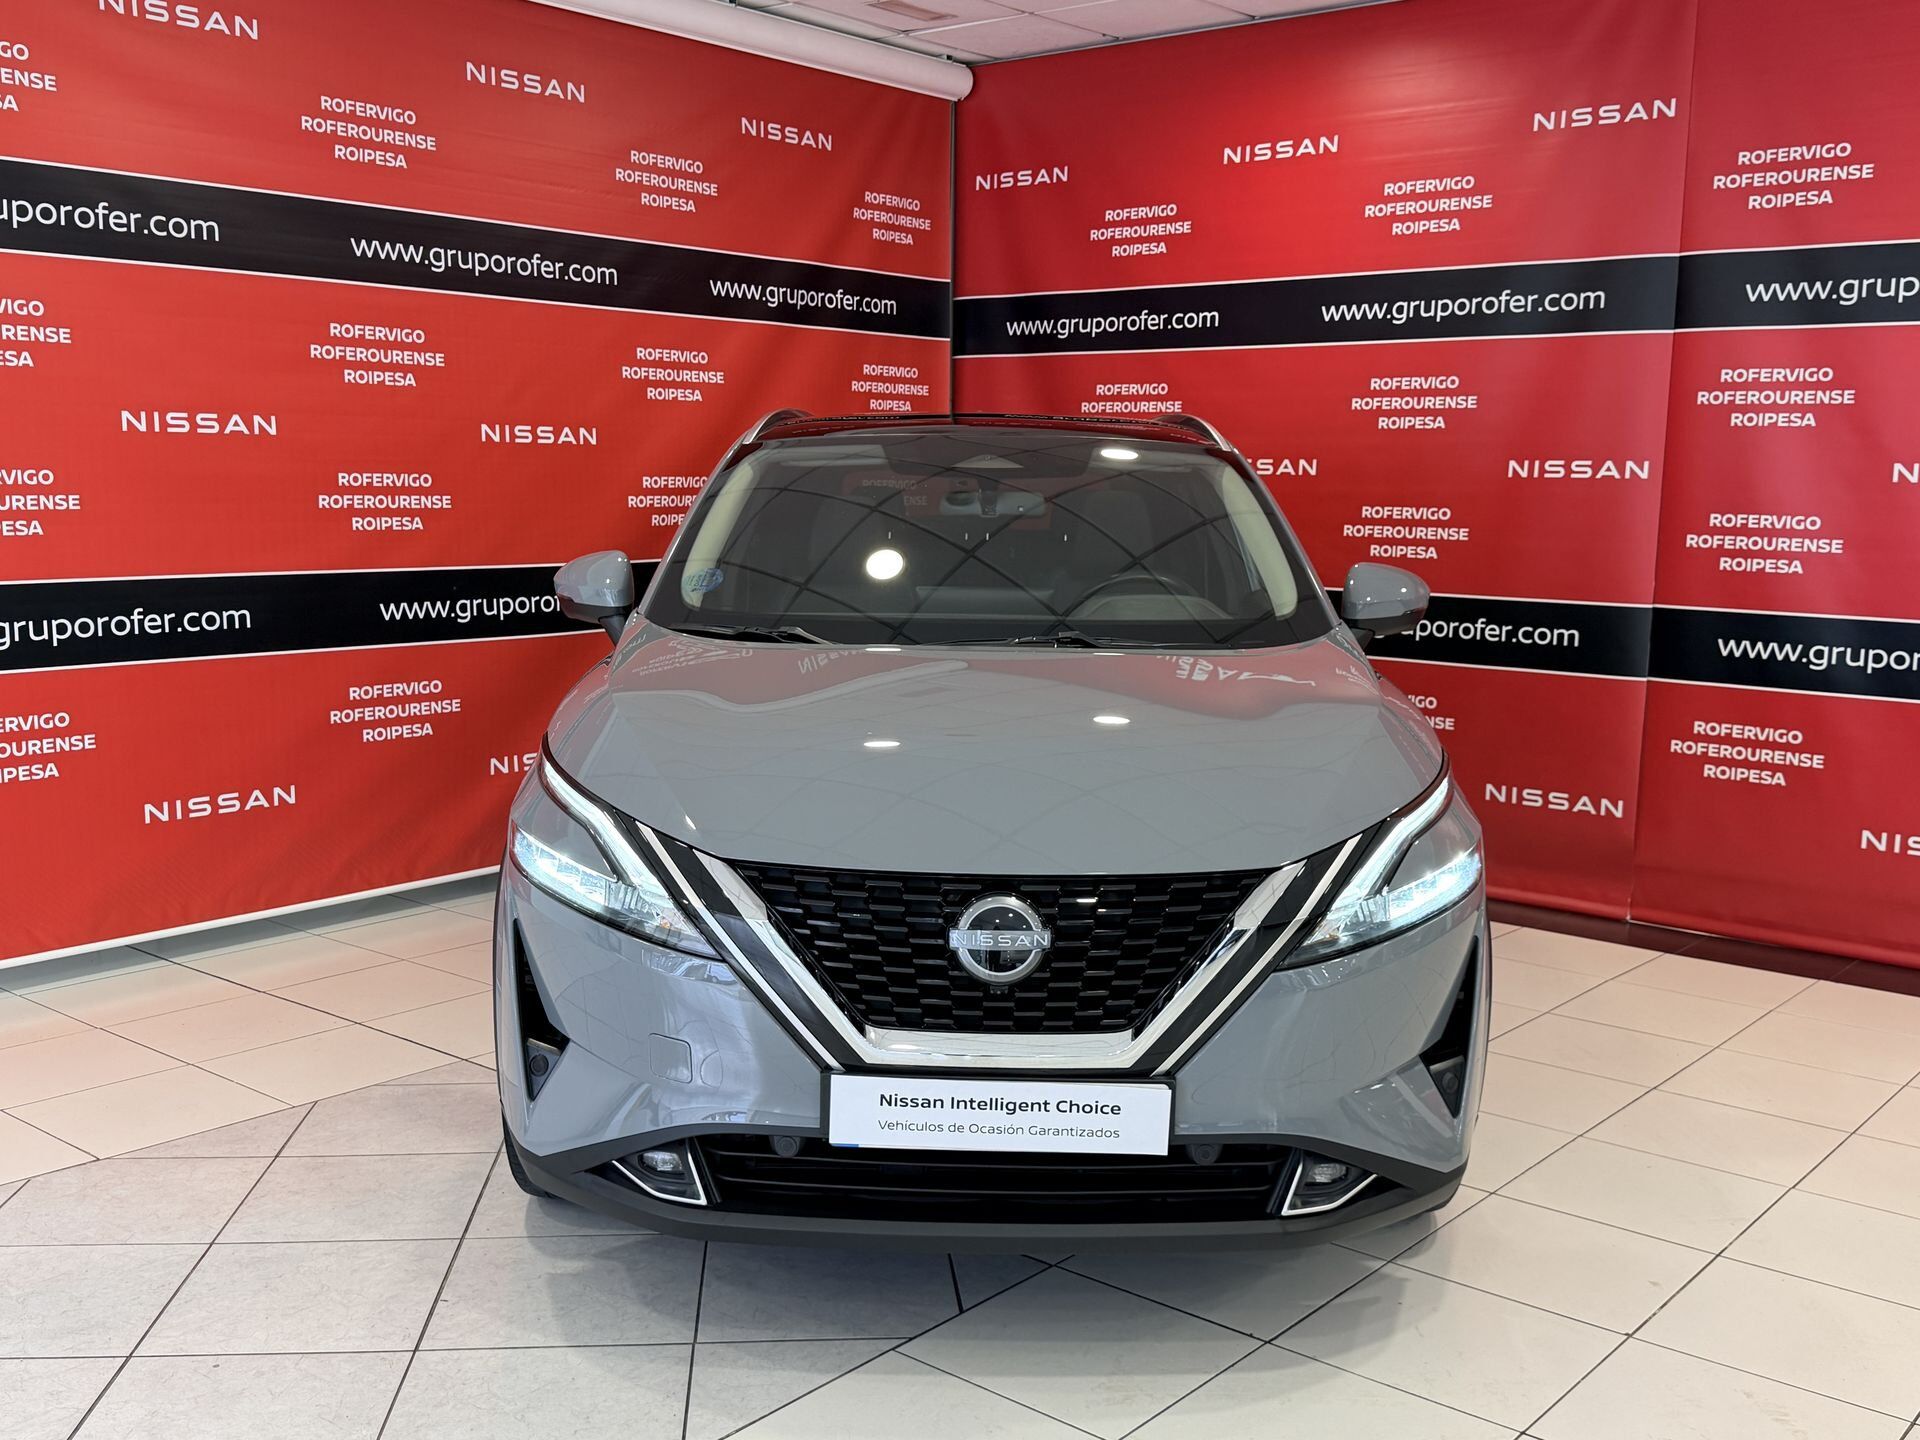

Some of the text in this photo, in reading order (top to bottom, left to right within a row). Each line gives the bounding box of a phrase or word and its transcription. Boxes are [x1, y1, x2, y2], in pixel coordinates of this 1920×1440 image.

[98, 0, 258, 40] NISSAN
[466, 62, 586, 103] NISSAN
[320, 96, 416, 125] ROFERVIGO
[1533, 98, 1677, 132] NISSAN
[301, 116, 436, 151] ROFEROURENSE
[741, 117, 832, 151] NISSAN
[334, 145, 407, 168] ROIPESA
[1223, 135, 1339, 164] NISSAN
[1737, 142, 1852, 165] ROFERVIGO
[630, 150, 703, 173] ROFERVIGO
[615, 168, 718, 197] ROFEROURENSE
[975, 166, 1069, 191] NISSAN
[1384, 176, 1475, 196] ROFERVIGO
[1713, 163, 1875, 190] ROFEROURENSE
[641, 193, 696, 213] ROIPESA
[864, 191, 921, 212] ROFERVIGO
[1364, 194, 1493, 218] ROFEROURENSE
[1748, 190, 1833, 210] ROIPESA
[853, 208, 931, 231] ROFEROURENSE
[1104, 204, 1177, 222] ROFERVIGO
[872, 228, 914, 245] ROIPESA
[1090, 220, 1192, 241] ROFEROURENSE
[1391, 218, 1461, 235] ROIPESA
[1111, 243, 1167, 257] ROIPESA
[350, 237, 618, 286] www.gruporofer.com
[709, 278, 897, 315] www.gruporofer.com
[1321, 289, 1606, 323] www.gruporofer.com
[329, 322, 425, 344] ROFERVIGO
[1006, 308, 1220, 339] www.gruporofer.com
[310, 344, 445, 367] ROFEROURENSE
[636, 348, 709, 364] ROFERVIGO
[344, 369, 416, 387] ROIPESA
[621, 366, 725, 384] ROFEROURENSE
[862, 364, 918, 379] ROFERVIGO
[1720, 367, 1833, 383] ROFERVIGO
[851, 381, 929, 396] ROFEROURENSE
[1096, 383, 1168, 396] ROFERVIGO
[1370, 376, 1459, 391] ROFERVIGO
[646, 387, 703, 401] ROIPESA
[1351, 395, 1478, 411] ROFEROURENSE
[1696, 389, 1855, 405] ROFEROURENSE
[869, 399, 912, 412] ROIPESA
[1081, 401, 1182, 414] ROFEROURENSE
[121, 410, 277, 435] NISSAN
[1378, 415, 1445, 430] ROIPESA
[1730, 412, 1816, 427] ROIPESA
[480, 424, 598, 445] NISSAN
[0, 469, 54, 485] VIGO
[1247, 459, 1317, 475] SAN
[1508, 460, 1650, 479] NISSAN
[338, 472, 432, 487] ROFERVIGO
[318, 494, 452, 509] ROFEROURENSE
[352, 516, 423, 531] ROIPESA
[1361, 506, 1451, 521] ROFERVIGO
[1709, 513, 1822, 531] ROFERVIGO
[1343, 524, 1469, 541] ROFEROURENSE
[1370, 544, 1437, 560] ROIPESA
[1686, 534, 1844, 554] ROFEROURENSE
[1719, 557, 1803, 574] ROIPESA
[349, 679, 442, 700] ROFERVIGO
[330, 699, 461, 724] ROFEROURENSE
[362, 722, 433, 743] ROIPESA
[1693, 721, 1803, 745] ROFERVIGO
[1670, 739, 1825, 769] ROFEROURENSE
[1703, 765, 1786, 787] ROIPESA
[144, 784, 296, 824] NISSAN
[1484, 783, 1624, 818] NISSAN
[952, 934, 1048, 947] NISSAN
[880, 1093, 1122, 1116] Nissan Intelligent Choice
[878, 1119, 1120, 1138] Vehículos de Ocasión Garantizados
